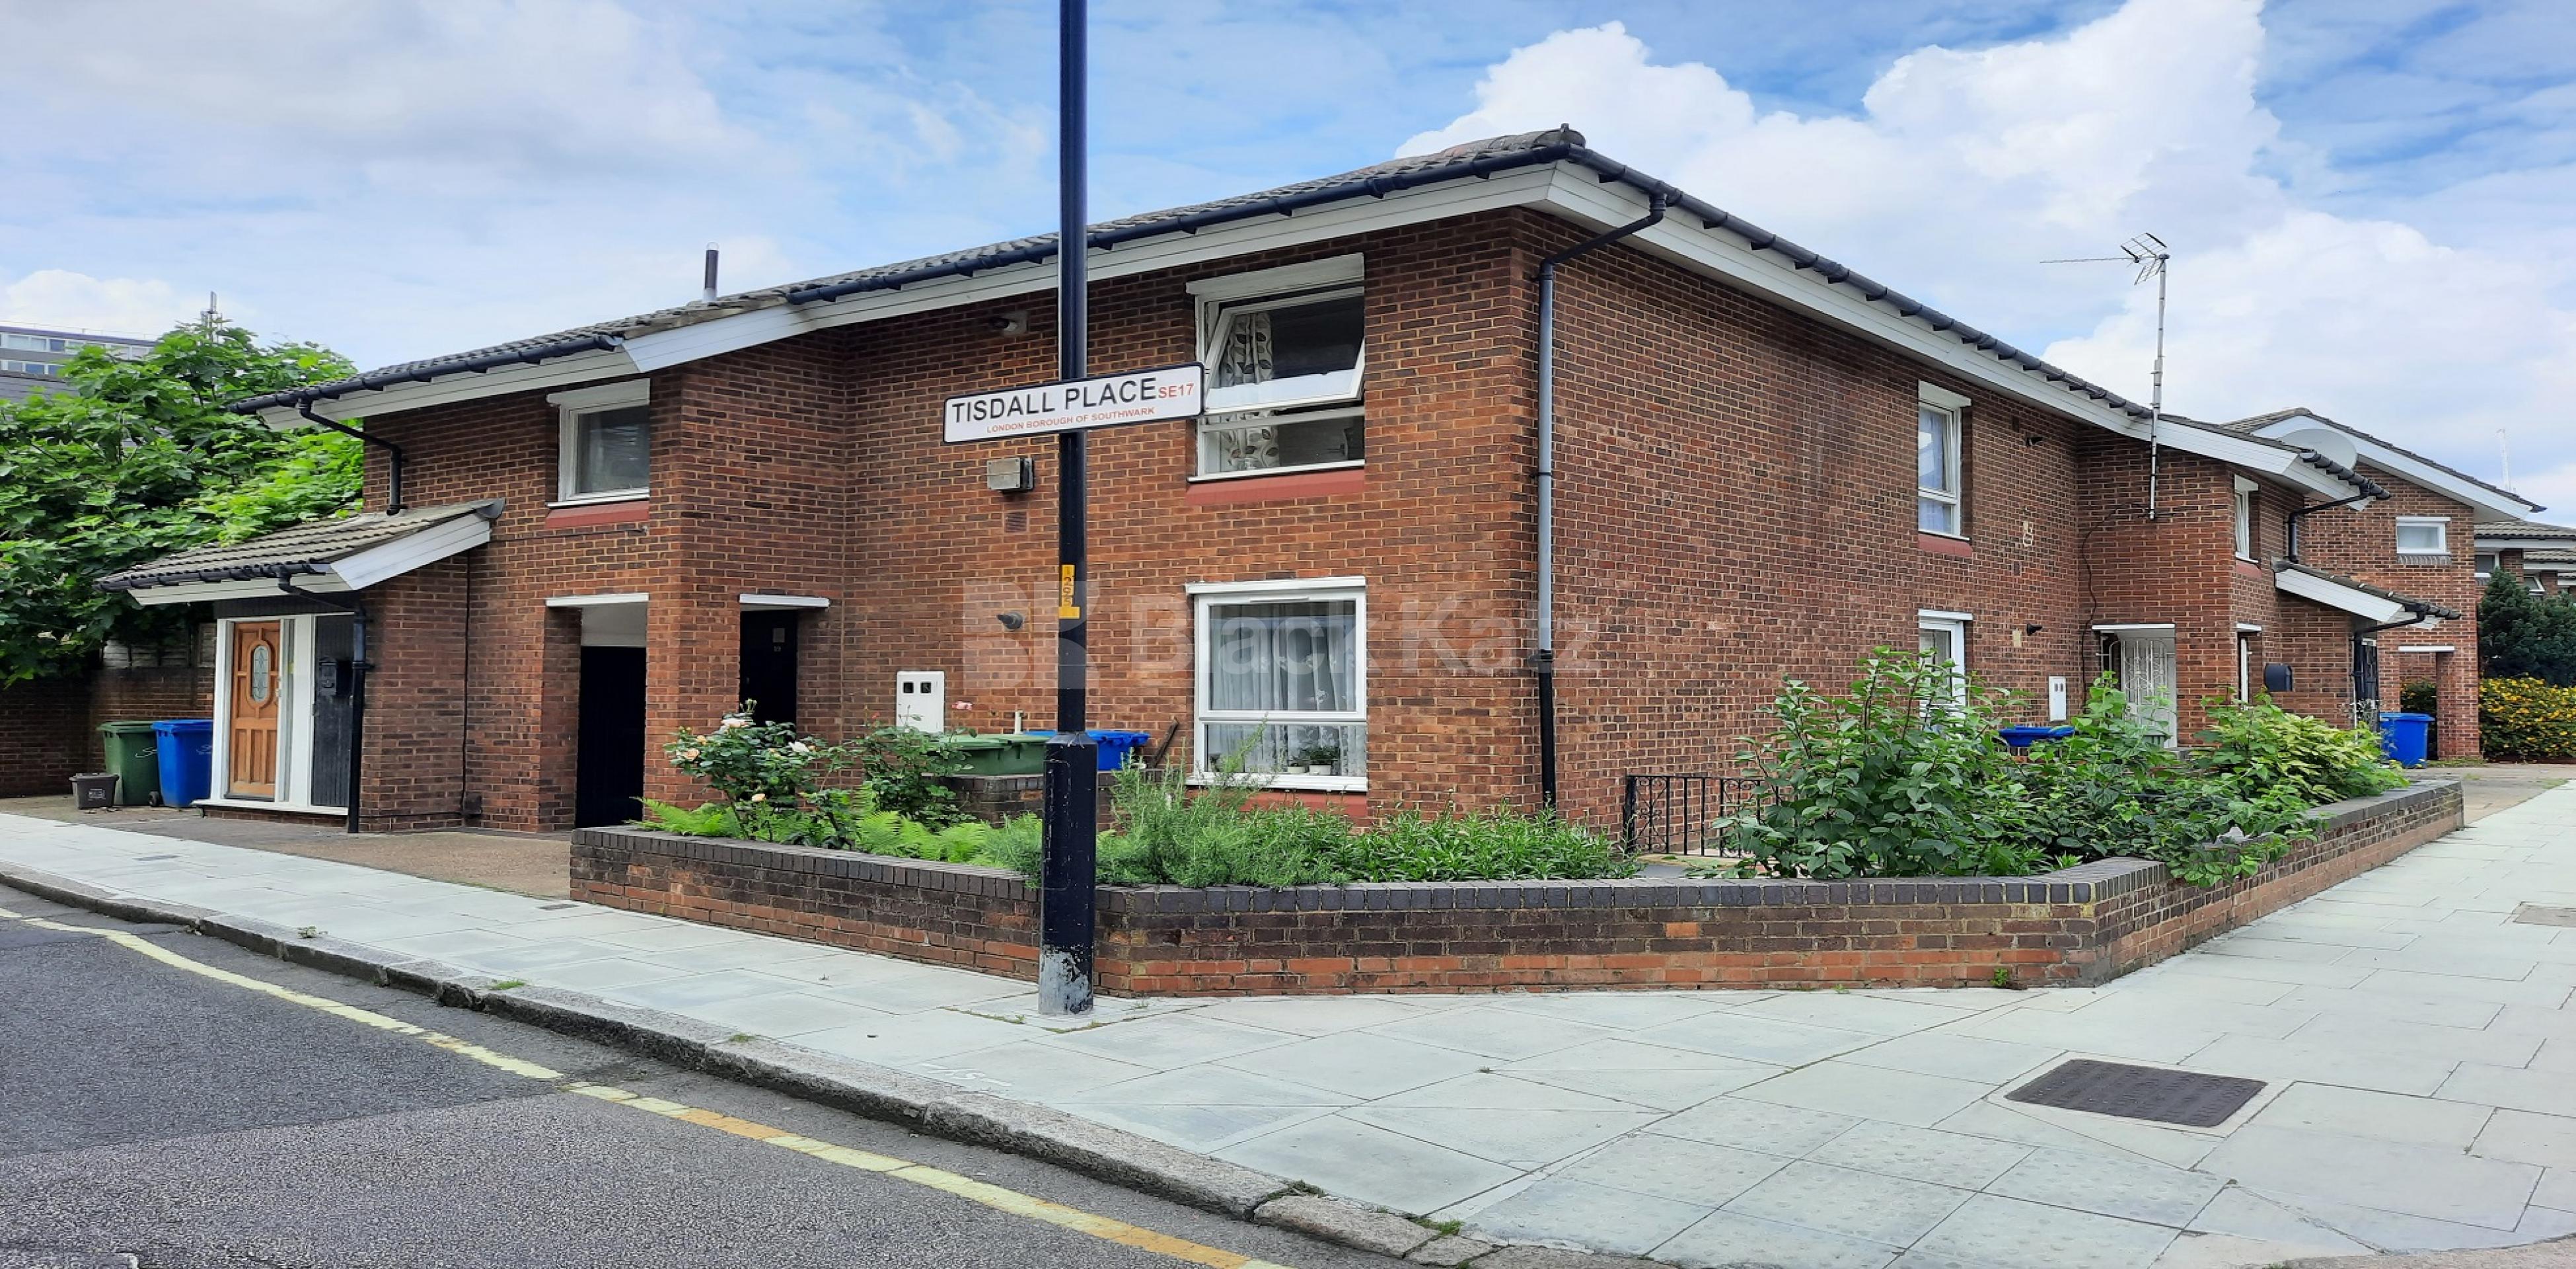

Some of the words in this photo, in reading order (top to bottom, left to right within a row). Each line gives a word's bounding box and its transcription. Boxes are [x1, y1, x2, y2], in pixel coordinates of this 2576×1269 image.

[952, 392, 1055, 423] TISDALL
[1064, 377, 1156, 410] PLACE
[1158, 383, 1194, 399] SE17
[986, 422, 1024, 434] LONDON
[1026, 417, 1074, 428] BOROUGH
[1076, 414, 1089, 422] OF
[1091, 407, 1155, 421] SOUTHWARK
